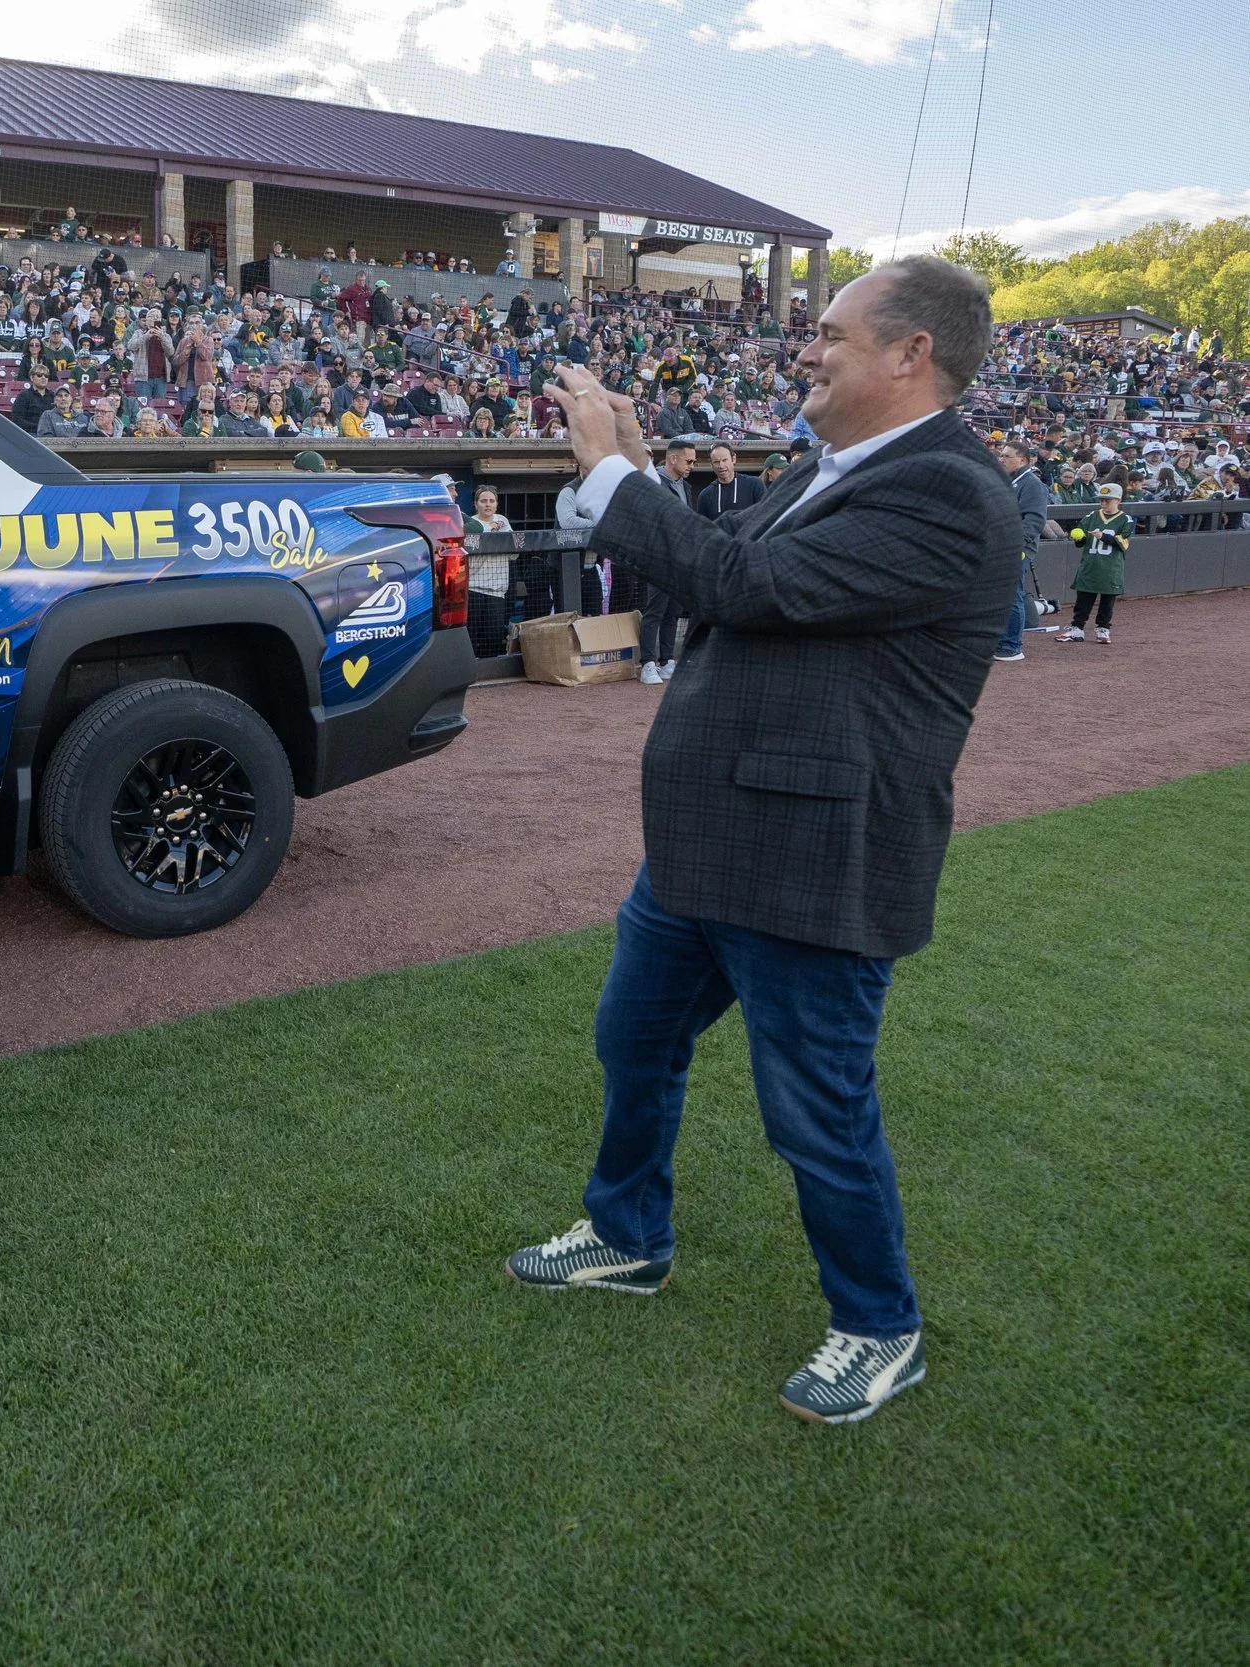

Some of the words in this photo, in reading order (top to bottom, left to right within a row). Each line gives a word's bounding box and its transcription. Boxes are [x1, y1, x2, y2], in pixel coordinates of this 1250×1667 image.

[655, 220, 700, 240] BEST
[703, 226, 755, 246] SEATS
[1116, 382, 1129, 395] 12
[188, 498, 313, 560] 3500
[269, 527, 328, 570] Sale
[335, 624, 406, 644] BERGSTROM
